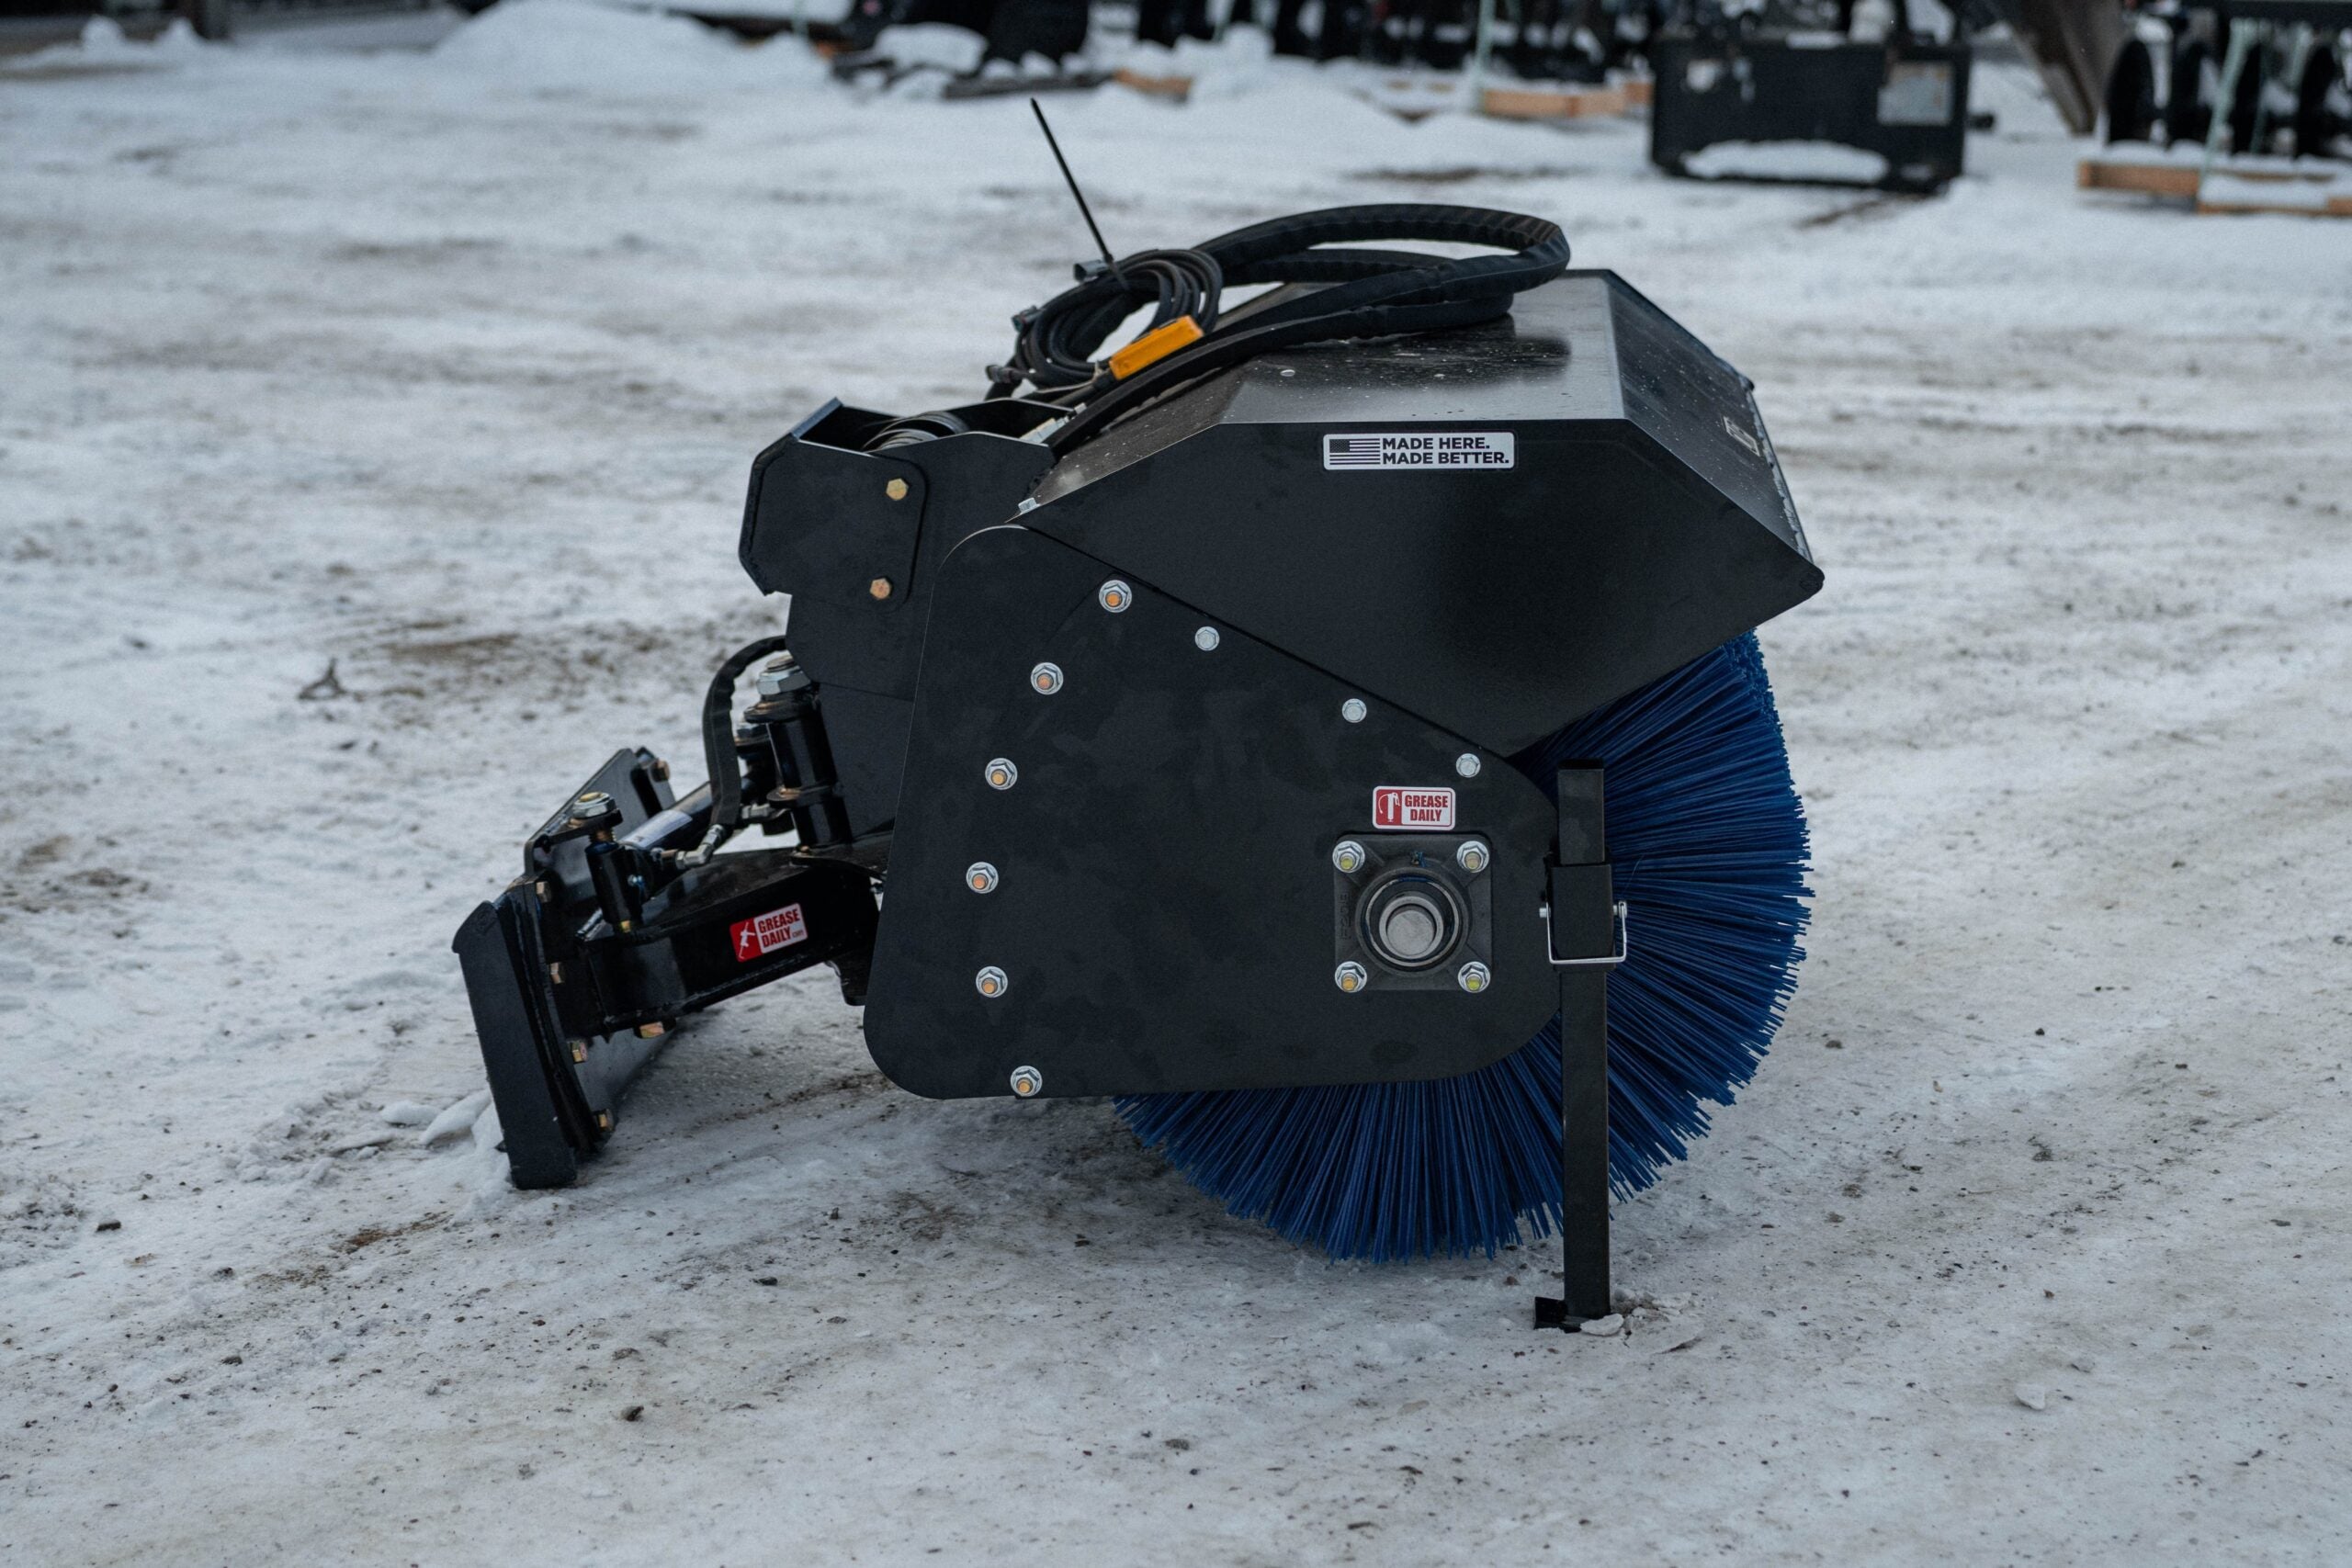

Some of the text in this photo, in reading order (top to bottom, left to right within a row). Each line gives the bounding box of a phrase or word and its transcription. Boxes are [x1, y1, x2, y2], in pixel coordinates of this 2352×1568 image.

[1383, 437, 1490, 449] MADE HERE.
[1383, 452, 1509, 464] MADE BETTER.
[1405, 795, 1448, 807] GREASE
[1410, 809, 1442, 821] DAILY
[758, 908, 800, 933] GREASE
[762, 926, 791, 947] DAILY
